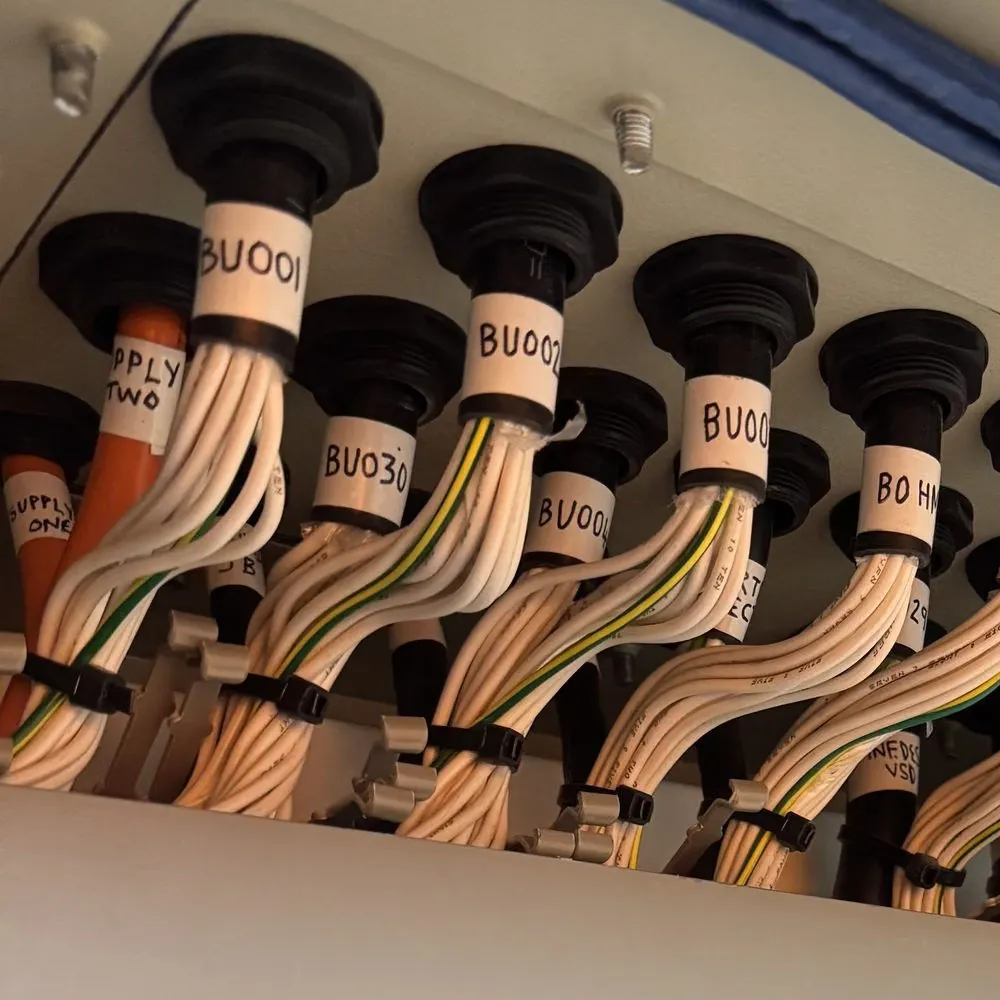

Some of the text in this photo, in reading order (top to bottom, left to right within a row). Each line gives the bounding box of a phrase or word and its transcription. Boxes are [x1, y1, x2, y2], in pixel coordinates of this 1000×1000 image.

[112, 347, 182, 388] PPLY
[105, 381, 160, 410] TWO
[703, 401, 769, 448] BU00
[28, 519, 72, 533] ONE
